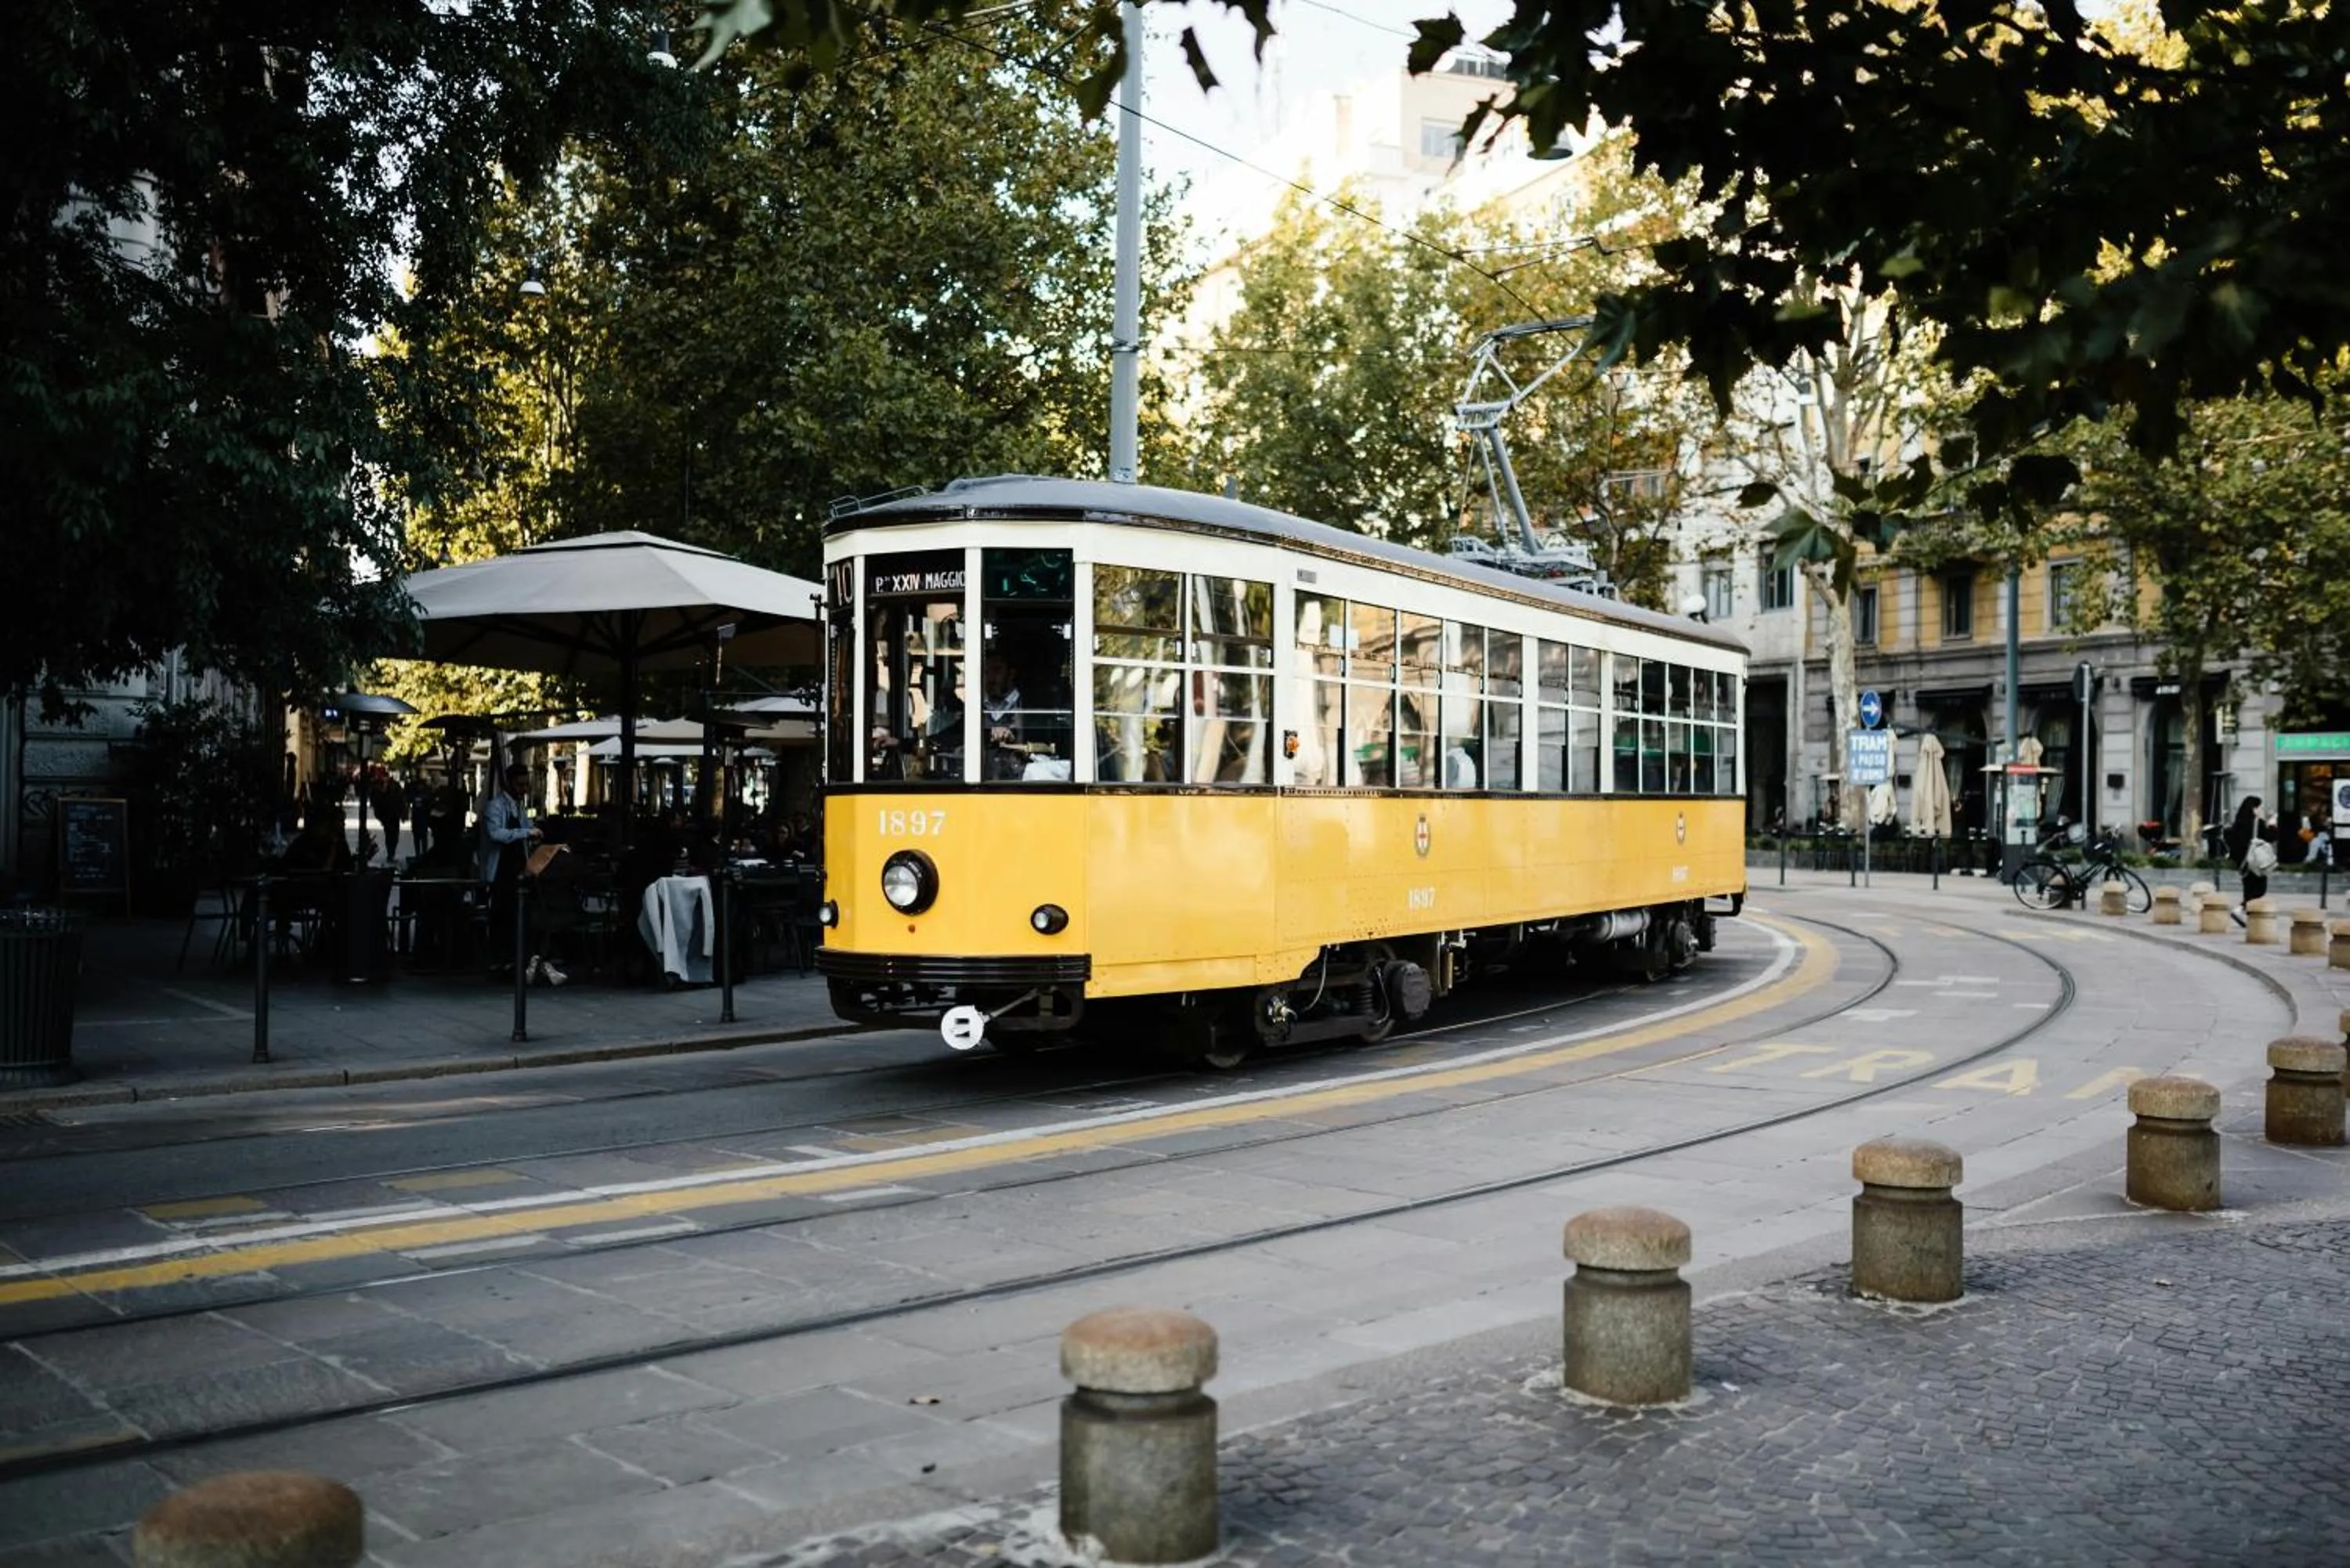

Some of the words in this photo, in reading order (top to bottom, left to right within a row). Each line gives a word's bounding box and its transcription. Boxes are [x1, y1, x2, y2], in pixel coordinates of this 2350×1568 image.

[836, 562, 853, 607] 10
[892, 573, 921, 591] XXIV
[925, 570, 966, 590] MAGGIO
[1849, 735, 1887, 751] TRAM
[879, 808, 946, 836] 1897
